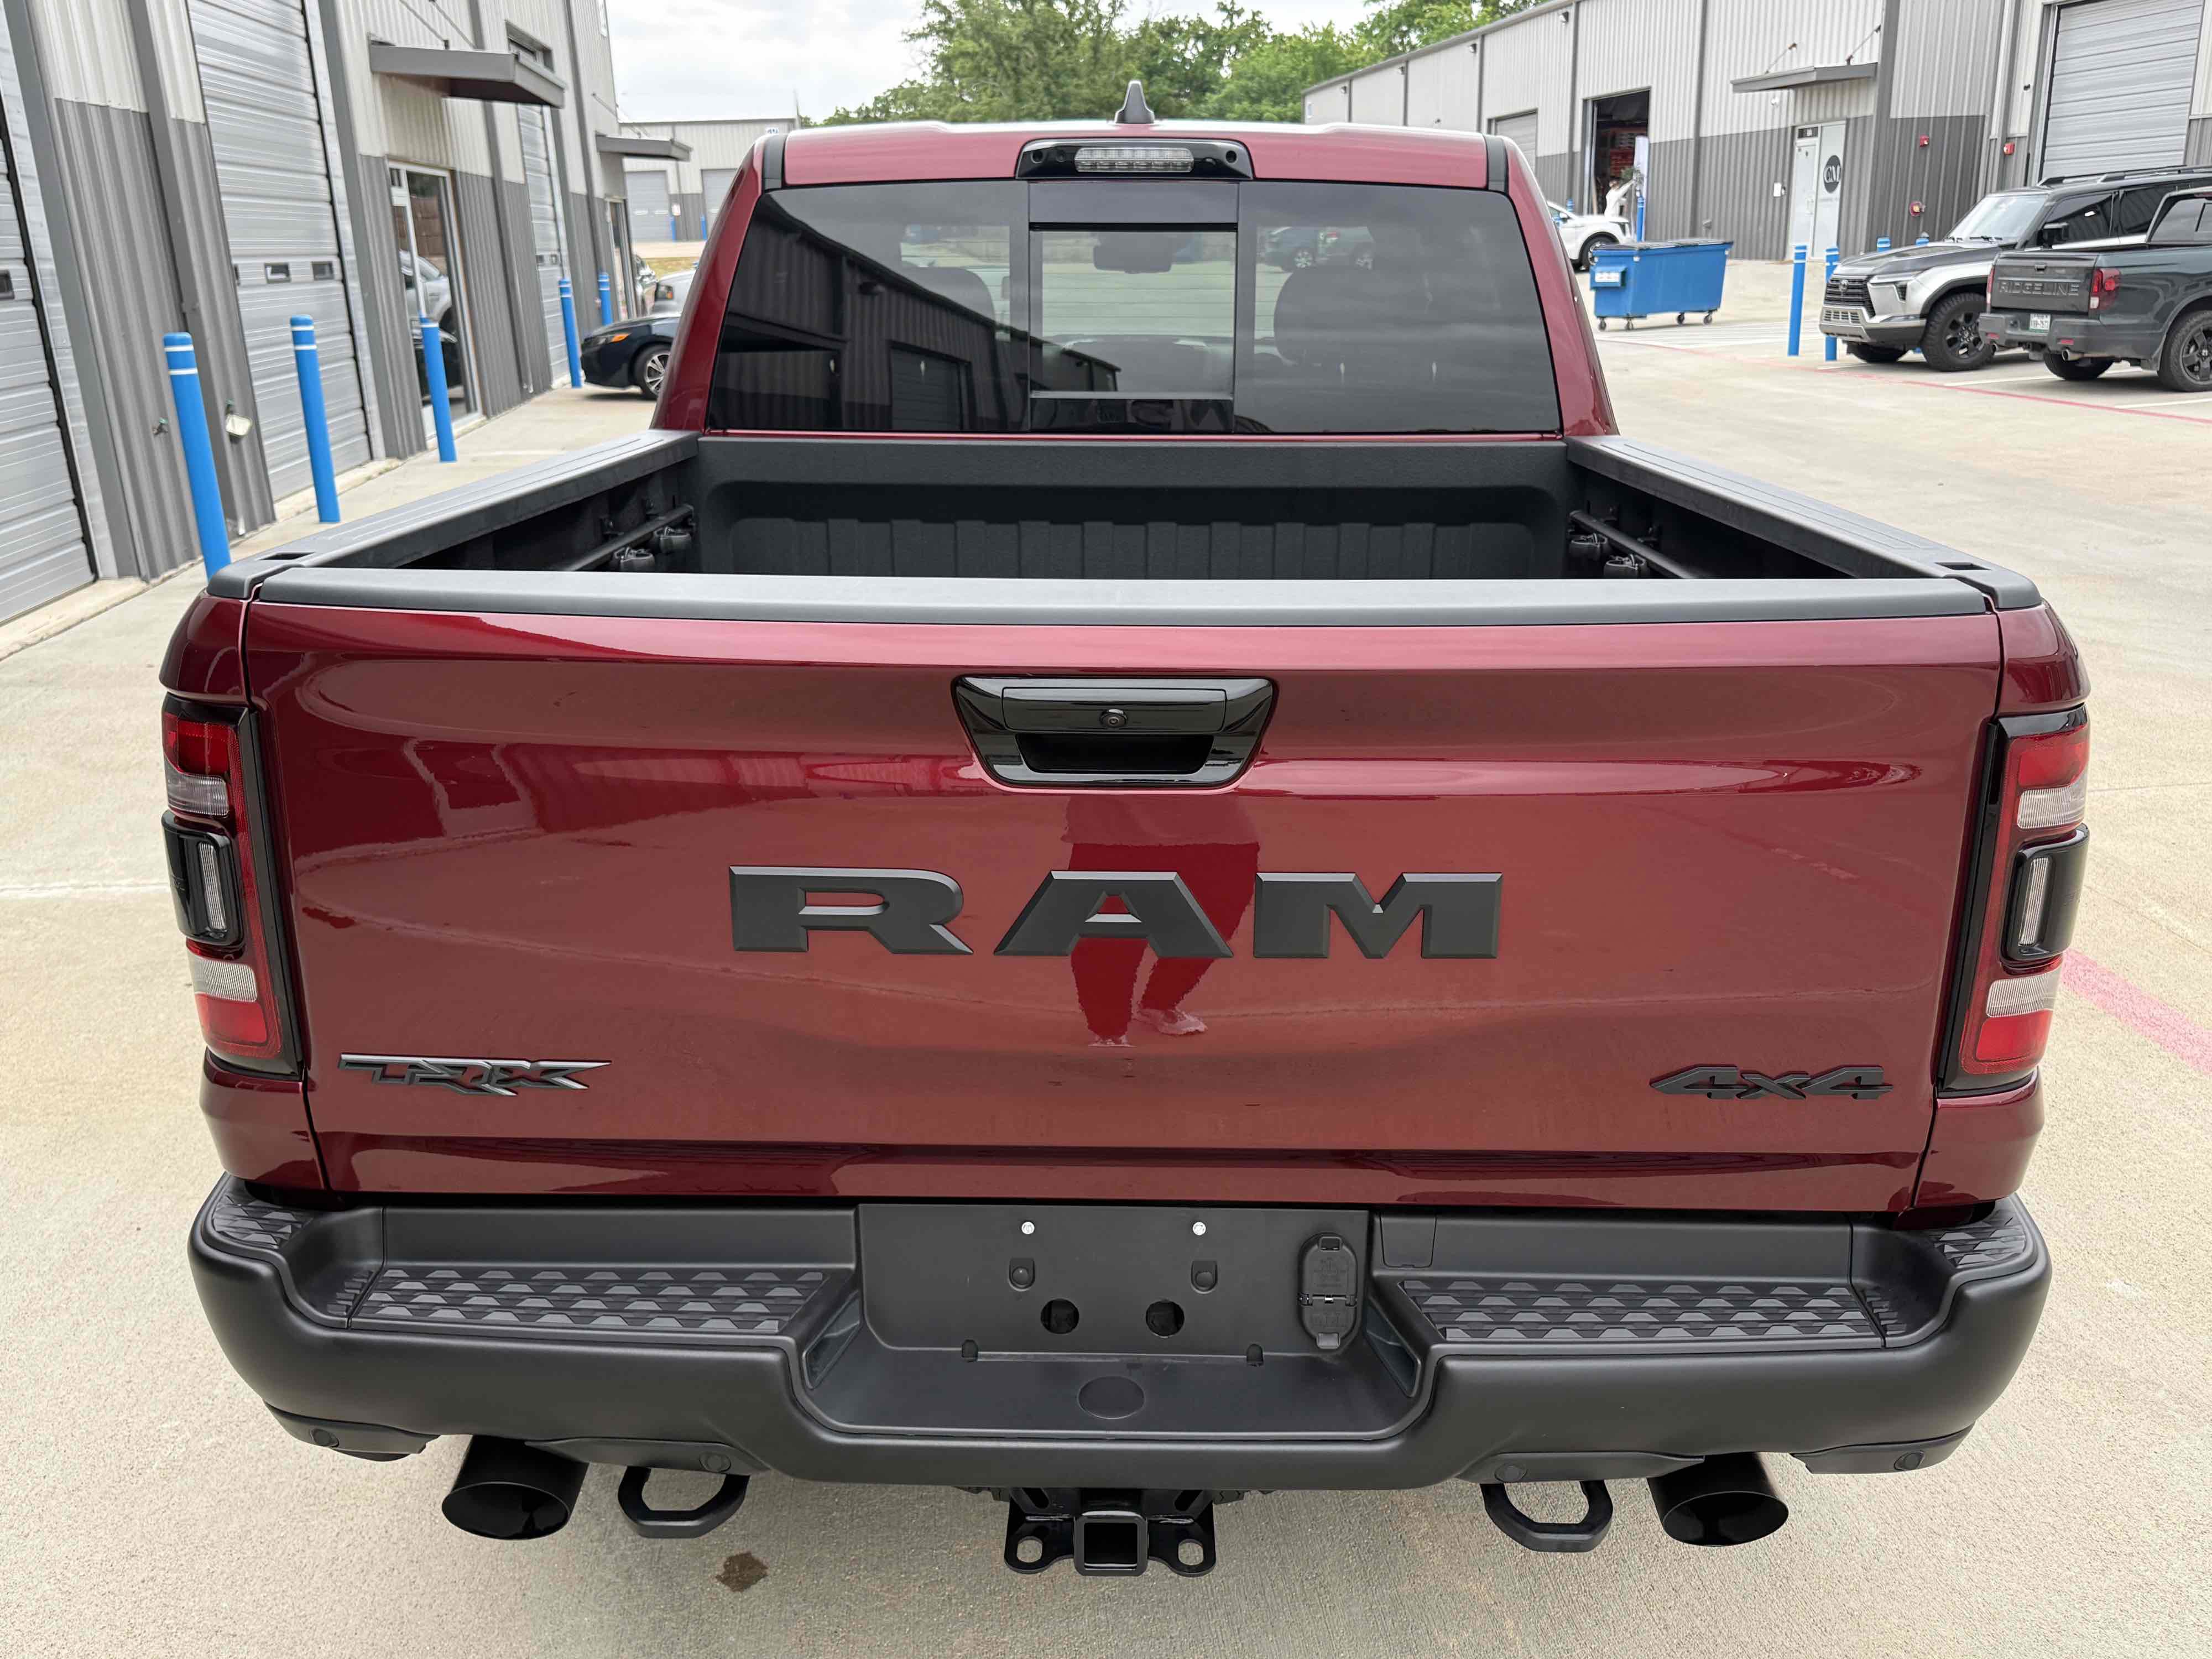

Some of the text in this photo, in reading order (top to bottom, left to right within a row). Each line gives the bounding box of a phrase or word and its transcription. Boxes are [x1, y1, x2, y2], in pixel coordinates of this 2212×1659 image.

[1999, 282, 2080, 296] RIDGELINE
[729, 865, 1503, 959] RAM
[337, 1052, 612, 1096] TRX
